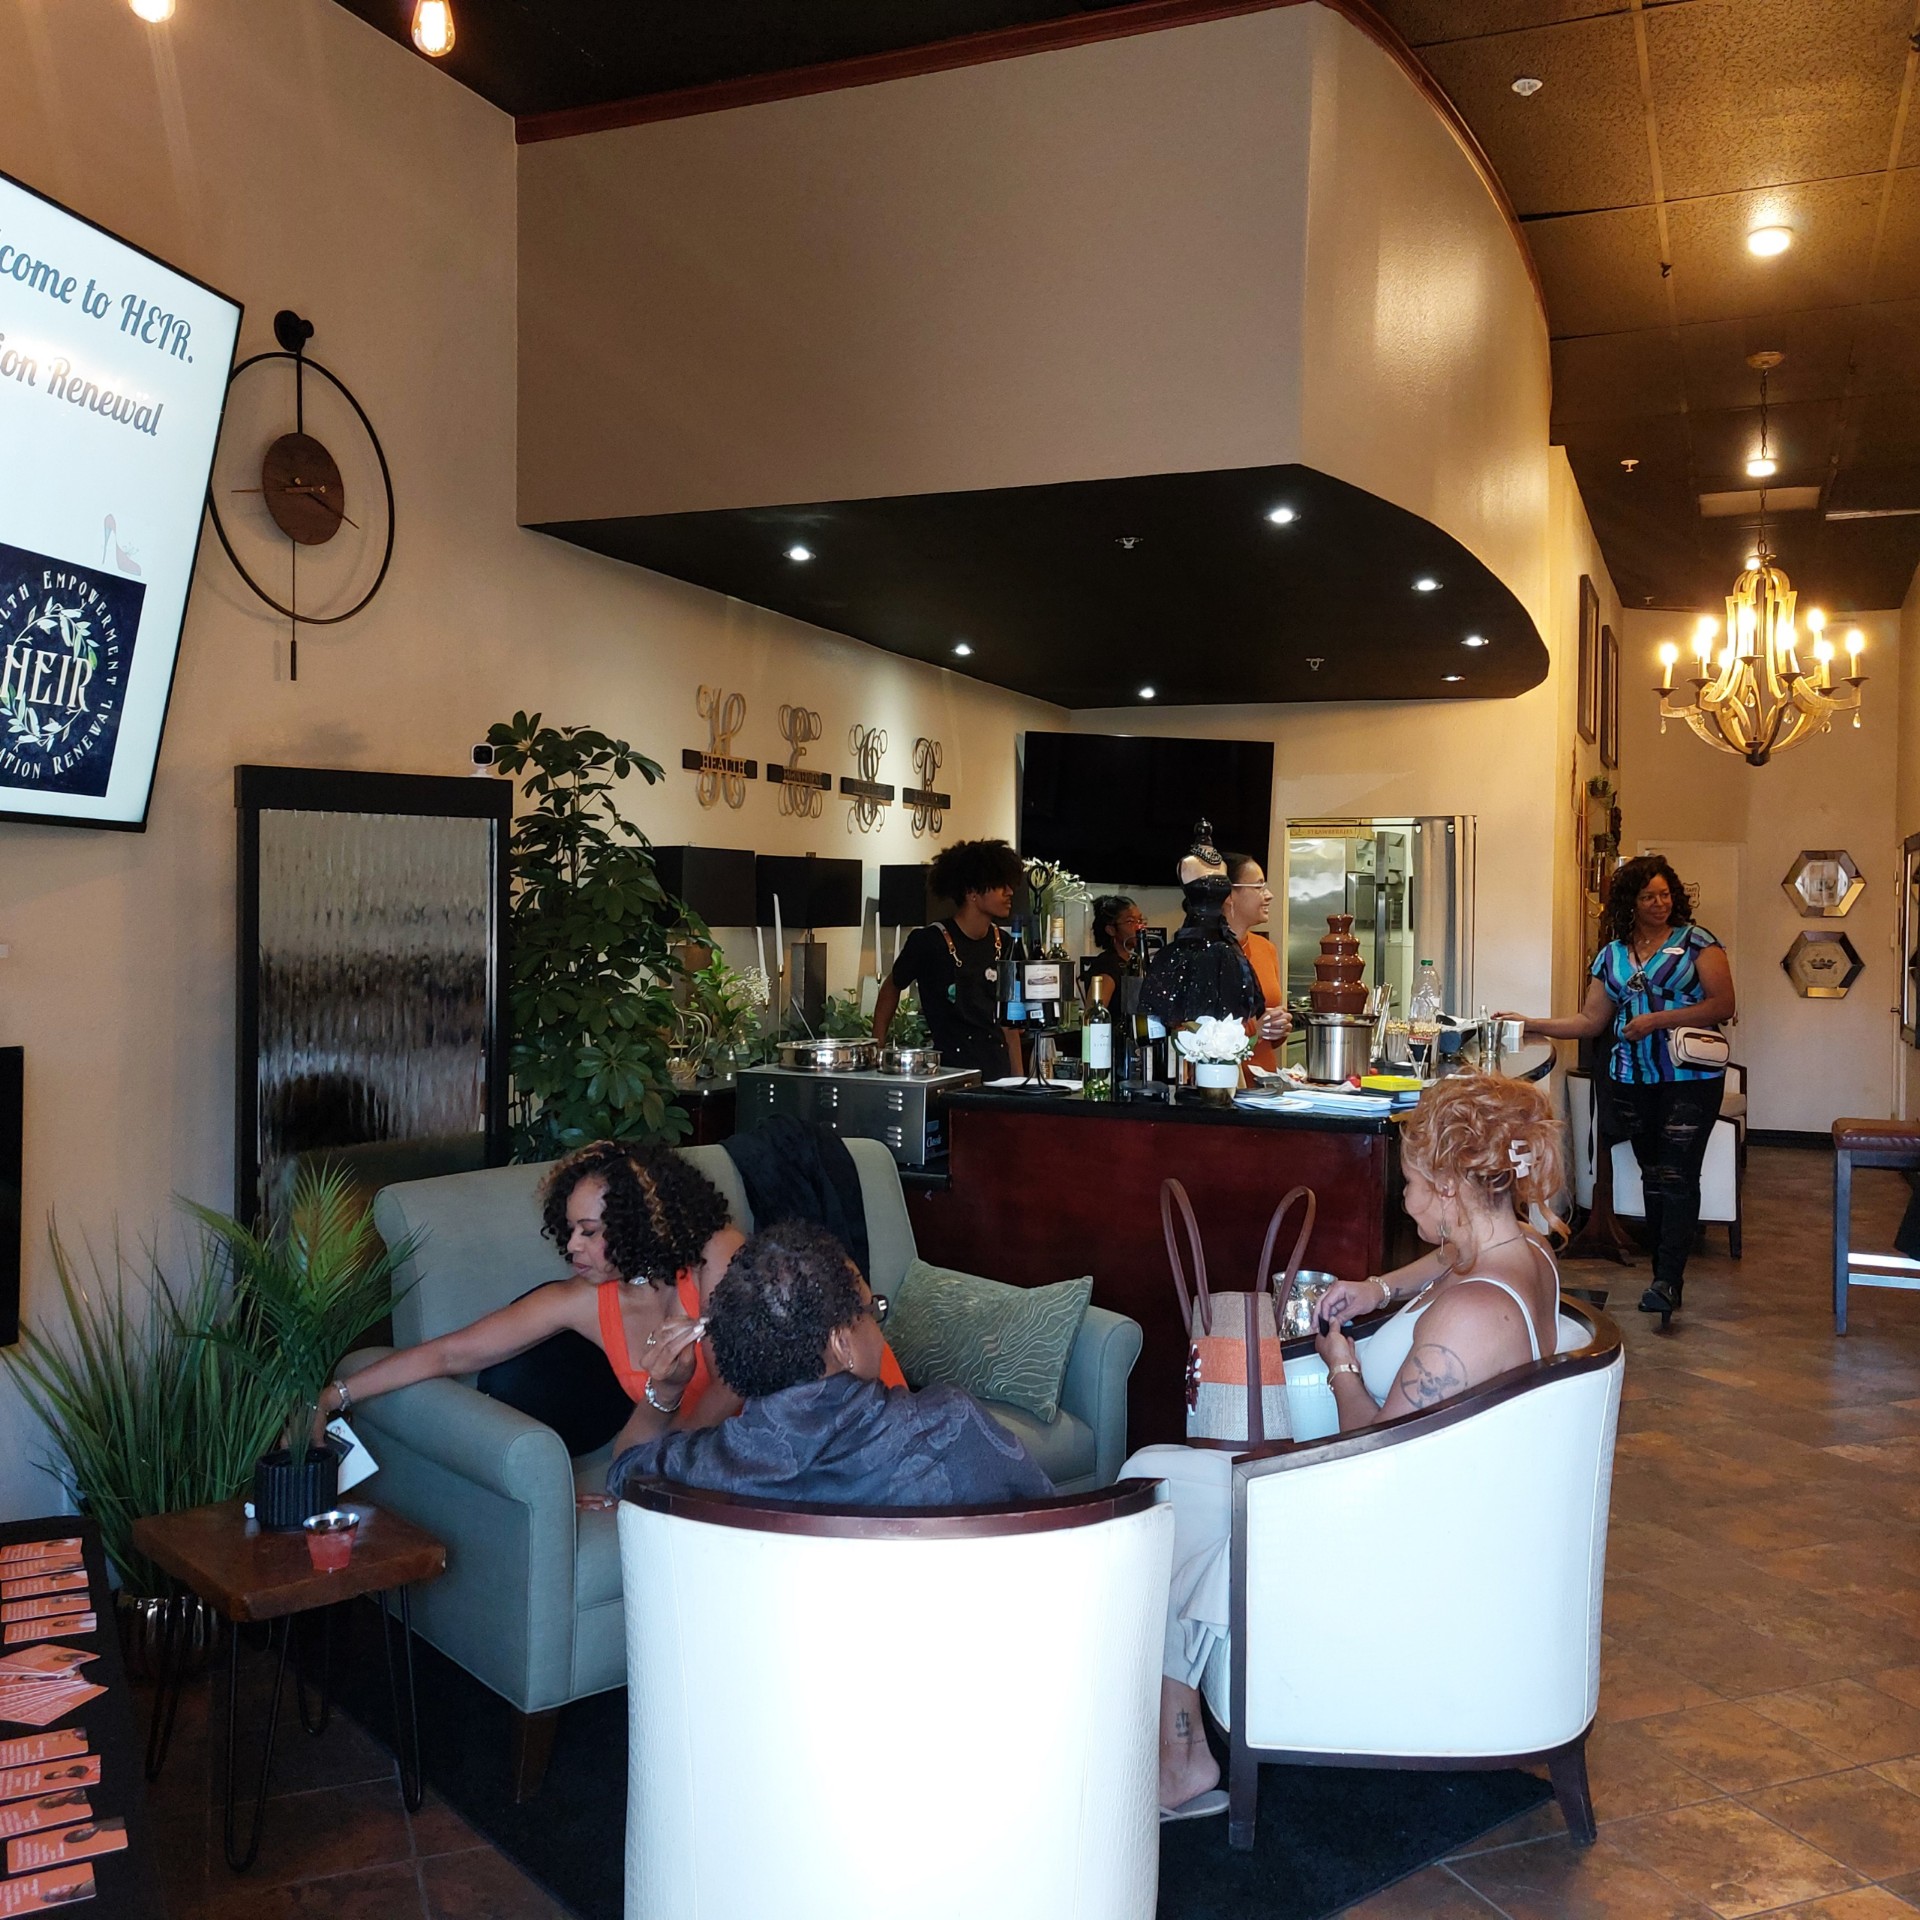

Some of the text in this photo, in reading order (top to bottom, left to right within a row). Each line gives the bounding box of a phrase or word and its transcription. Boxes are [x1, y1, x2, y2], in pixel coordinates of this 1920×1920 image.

[0, 229, 193, 364] come to HEIR.
[47, 357, 164, 437] Renewal
[0, 570, 119, 686] LTH EMPOWERMENT
[0, 644, 93, 713] HEIR
[53, 699, 113, 775] RENEWAL
[702, 754, 745, 774] HEALTH
